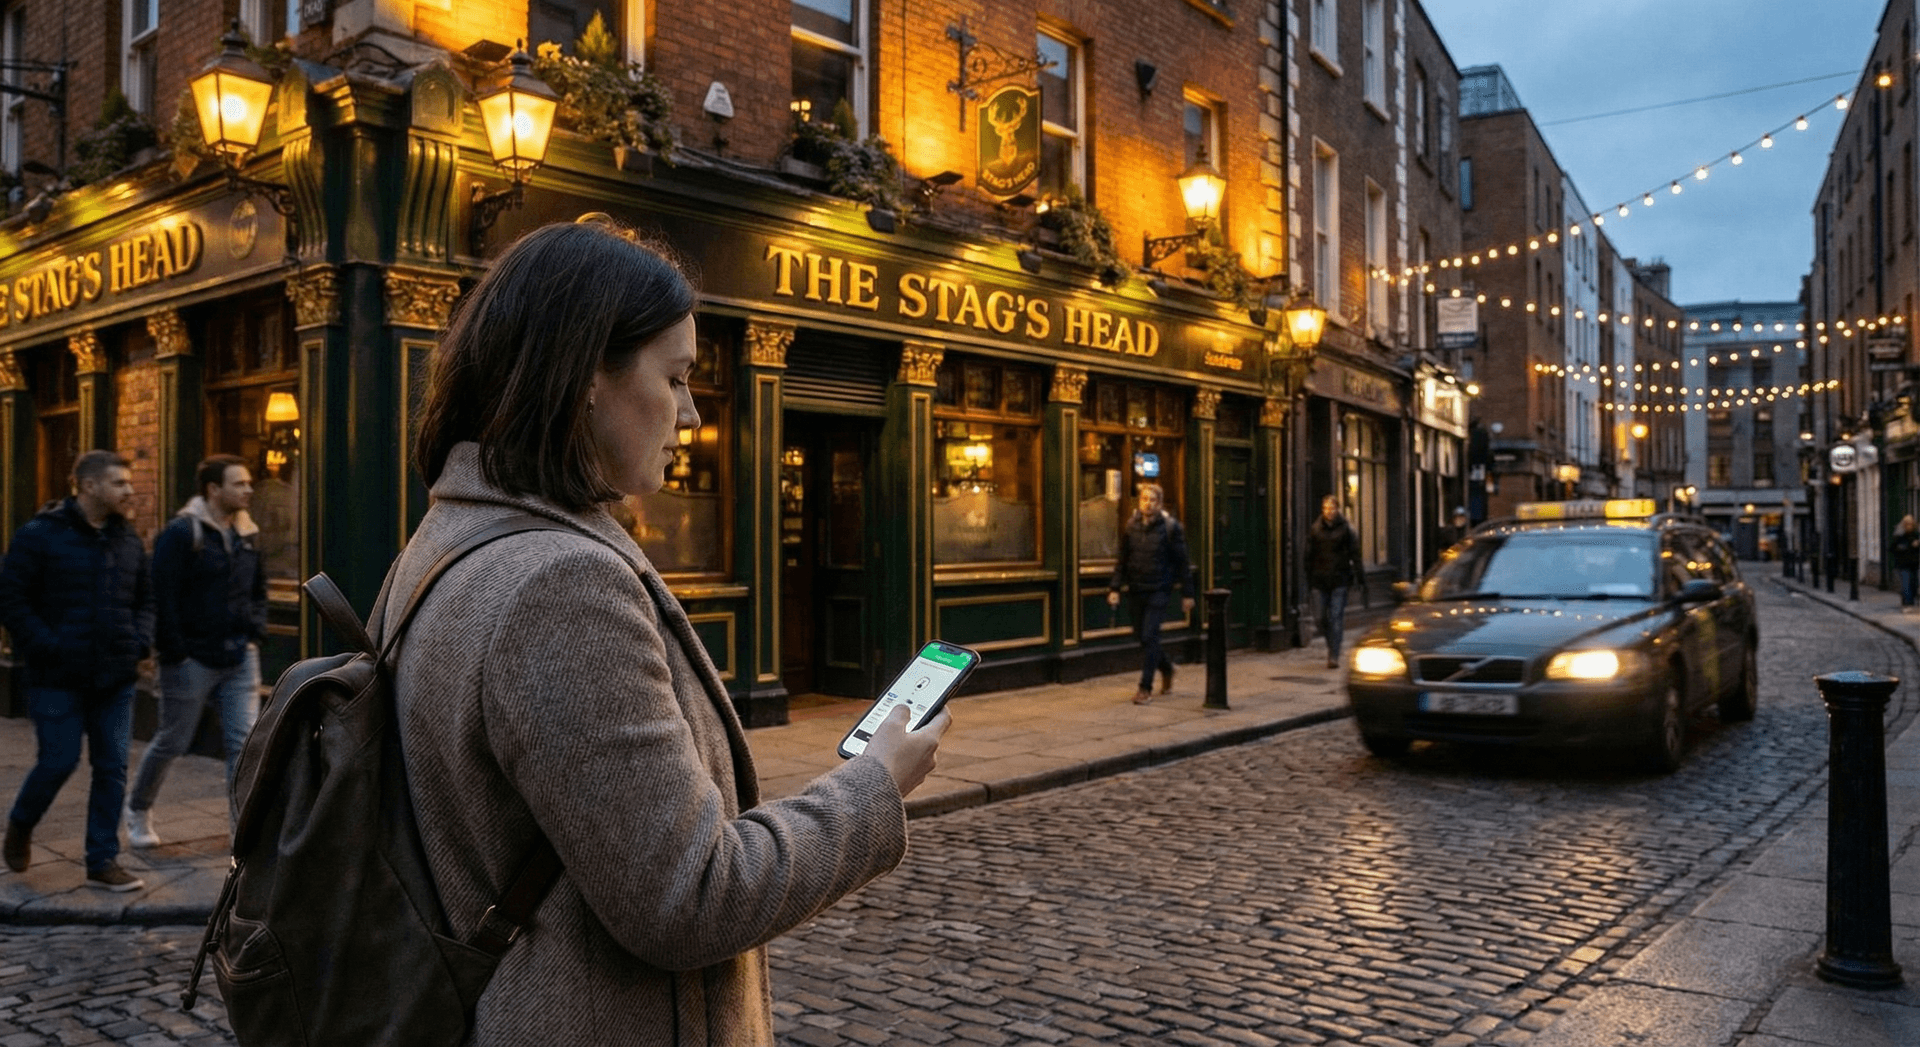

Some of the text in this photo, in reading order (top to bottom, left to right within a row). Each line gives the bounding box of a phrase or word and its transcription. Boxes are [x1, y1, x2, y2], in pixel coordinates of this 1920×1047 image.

[14, 252, 102, 323] STAG'S
[109, 222, 202, 292] HEAD
[766, 245, 1159, 357] THE STAG'S HEAD
